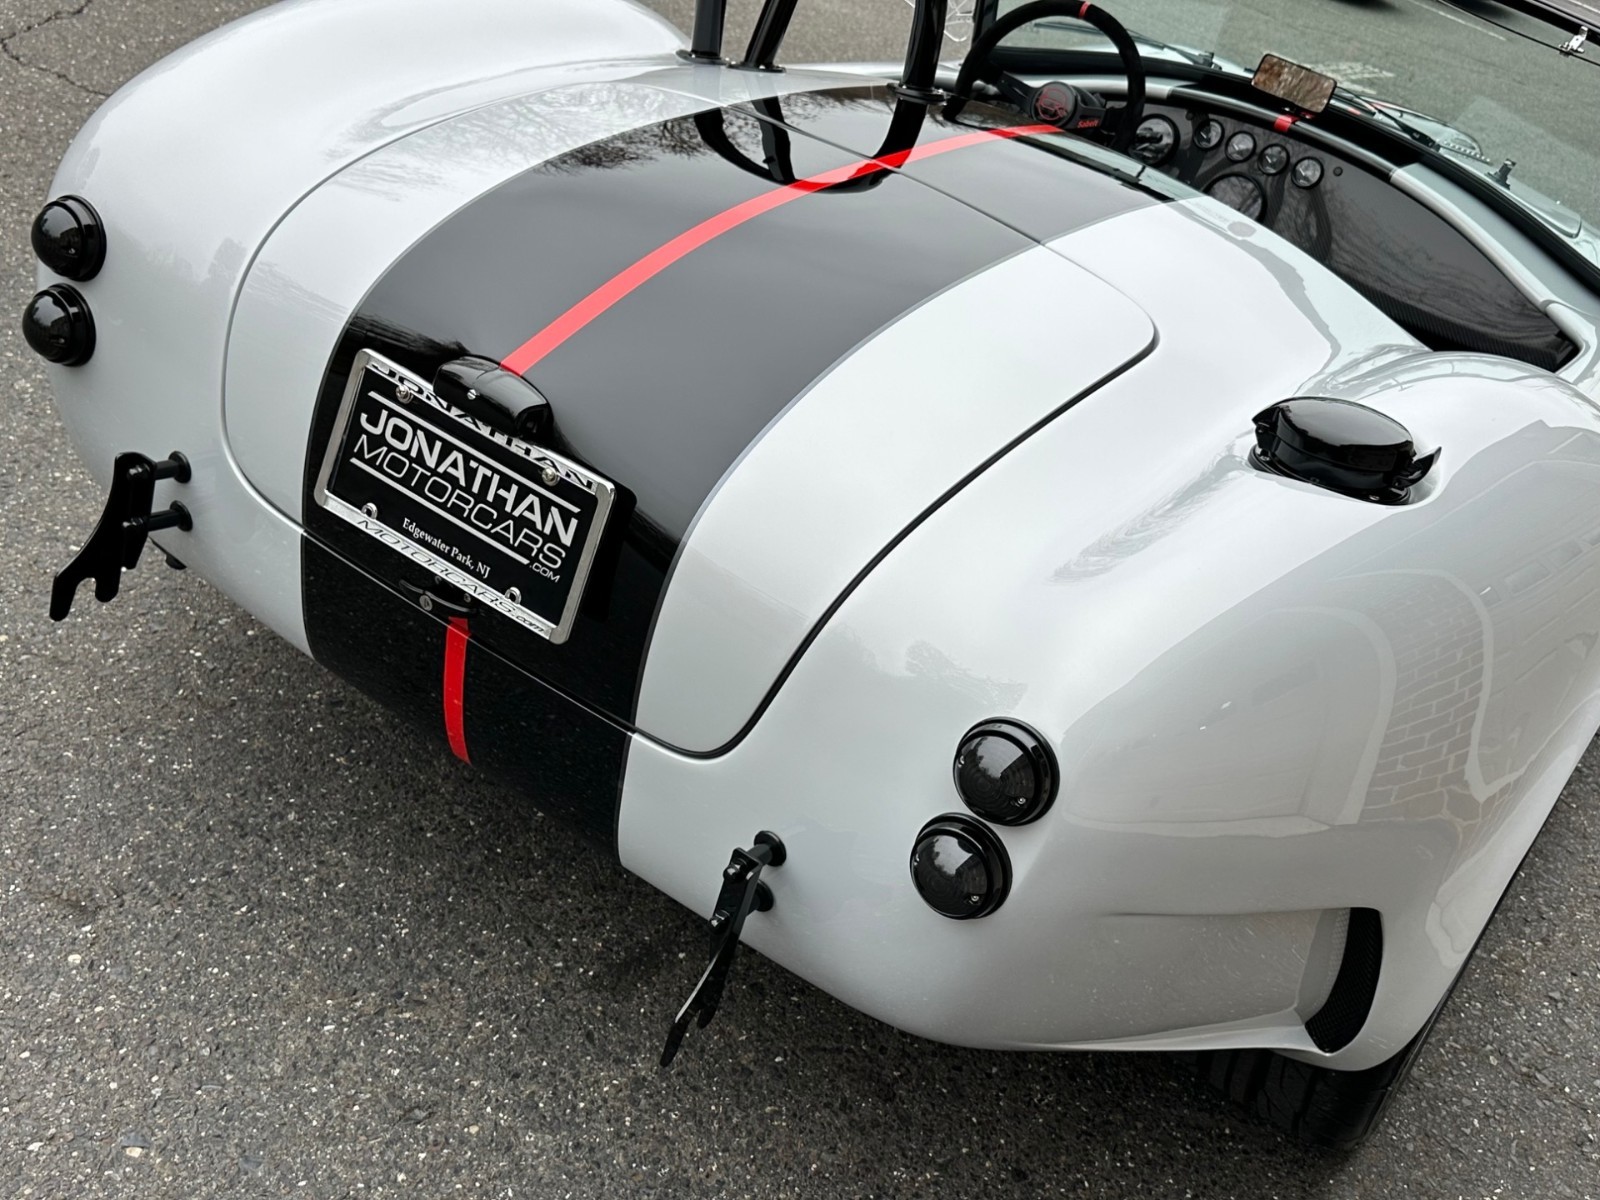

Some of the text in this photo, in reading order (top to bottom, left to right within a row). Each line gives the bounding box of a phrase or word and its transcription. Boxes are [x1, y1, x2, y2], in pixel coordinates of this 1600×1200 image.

[353, 434, 567, 570] MOTORCARS
[360, 409, 579, 547] JONATHAN
[402, 517, 492, 579] Edgewater Park, NJ
